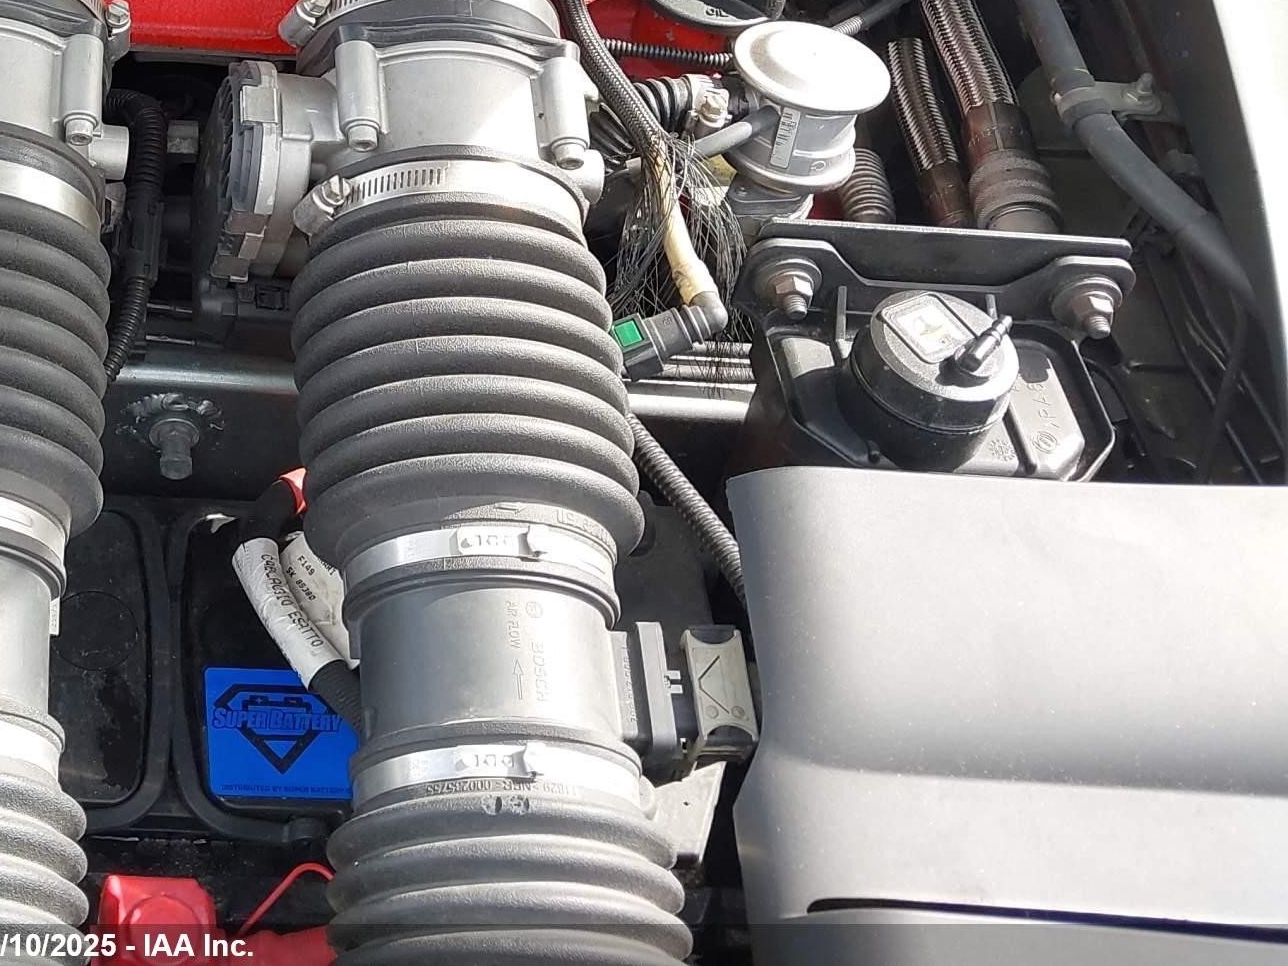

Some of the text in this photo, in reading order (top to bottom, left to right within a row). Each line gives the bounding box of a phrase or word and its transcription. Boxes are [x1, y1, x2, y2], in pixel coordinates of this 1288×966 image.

[705, 6, 728, 18] OIL
[530, 641, 549, 701] BOSCH
[212, 707, 341, 732] SUPER BATTERY
